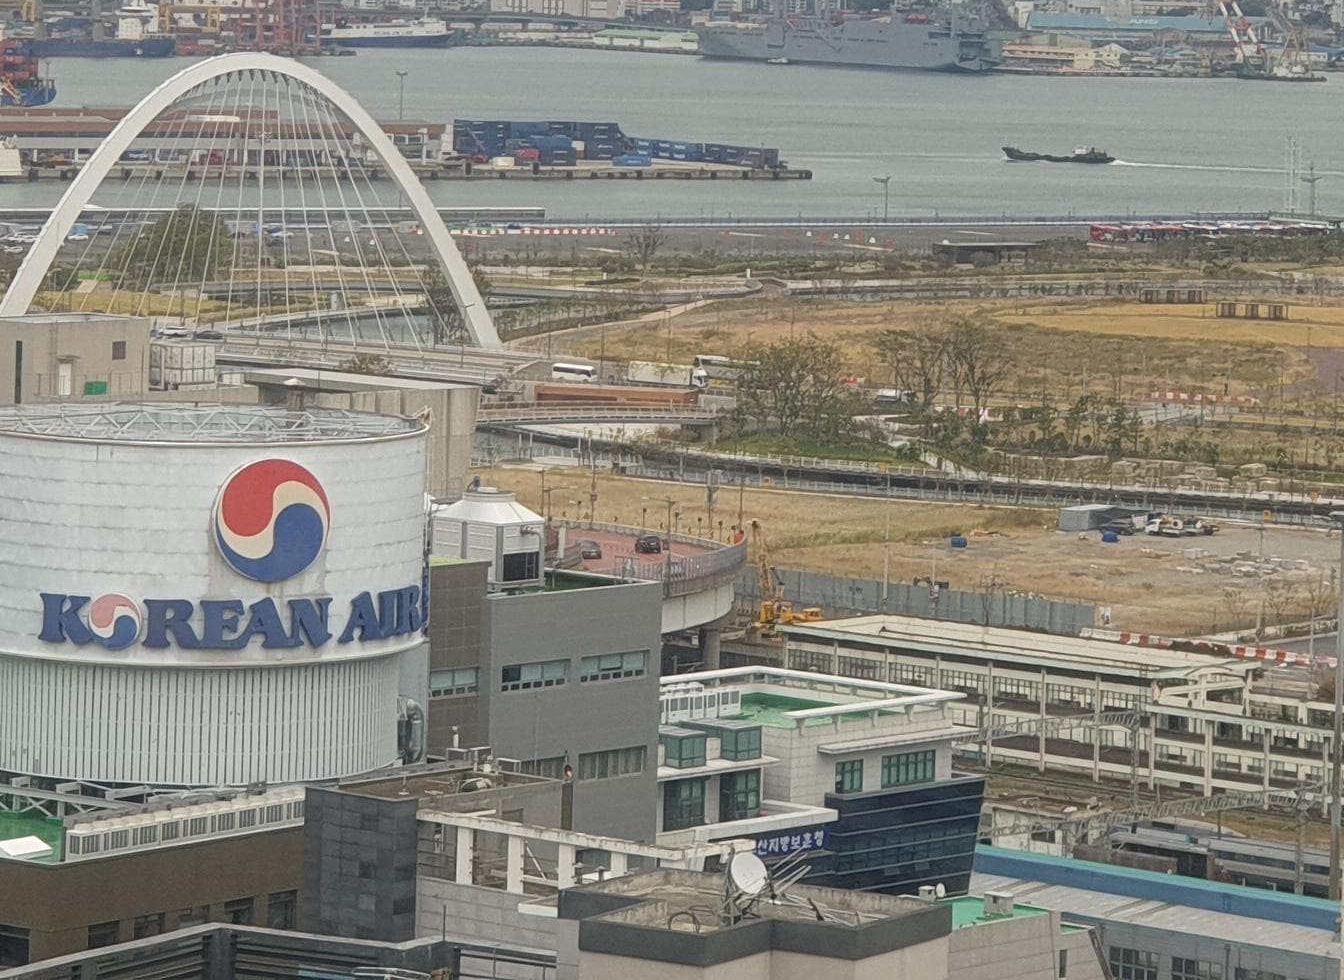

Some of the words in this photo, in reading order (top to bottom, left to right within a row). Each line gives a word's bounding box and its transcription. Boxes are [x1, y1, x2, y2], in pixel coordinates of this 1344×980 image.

[38, 592, 334, 651] KOREAN
[337, 584, 422, 644] AIR
[753, 830, 824, 856] 산지방보훈청
